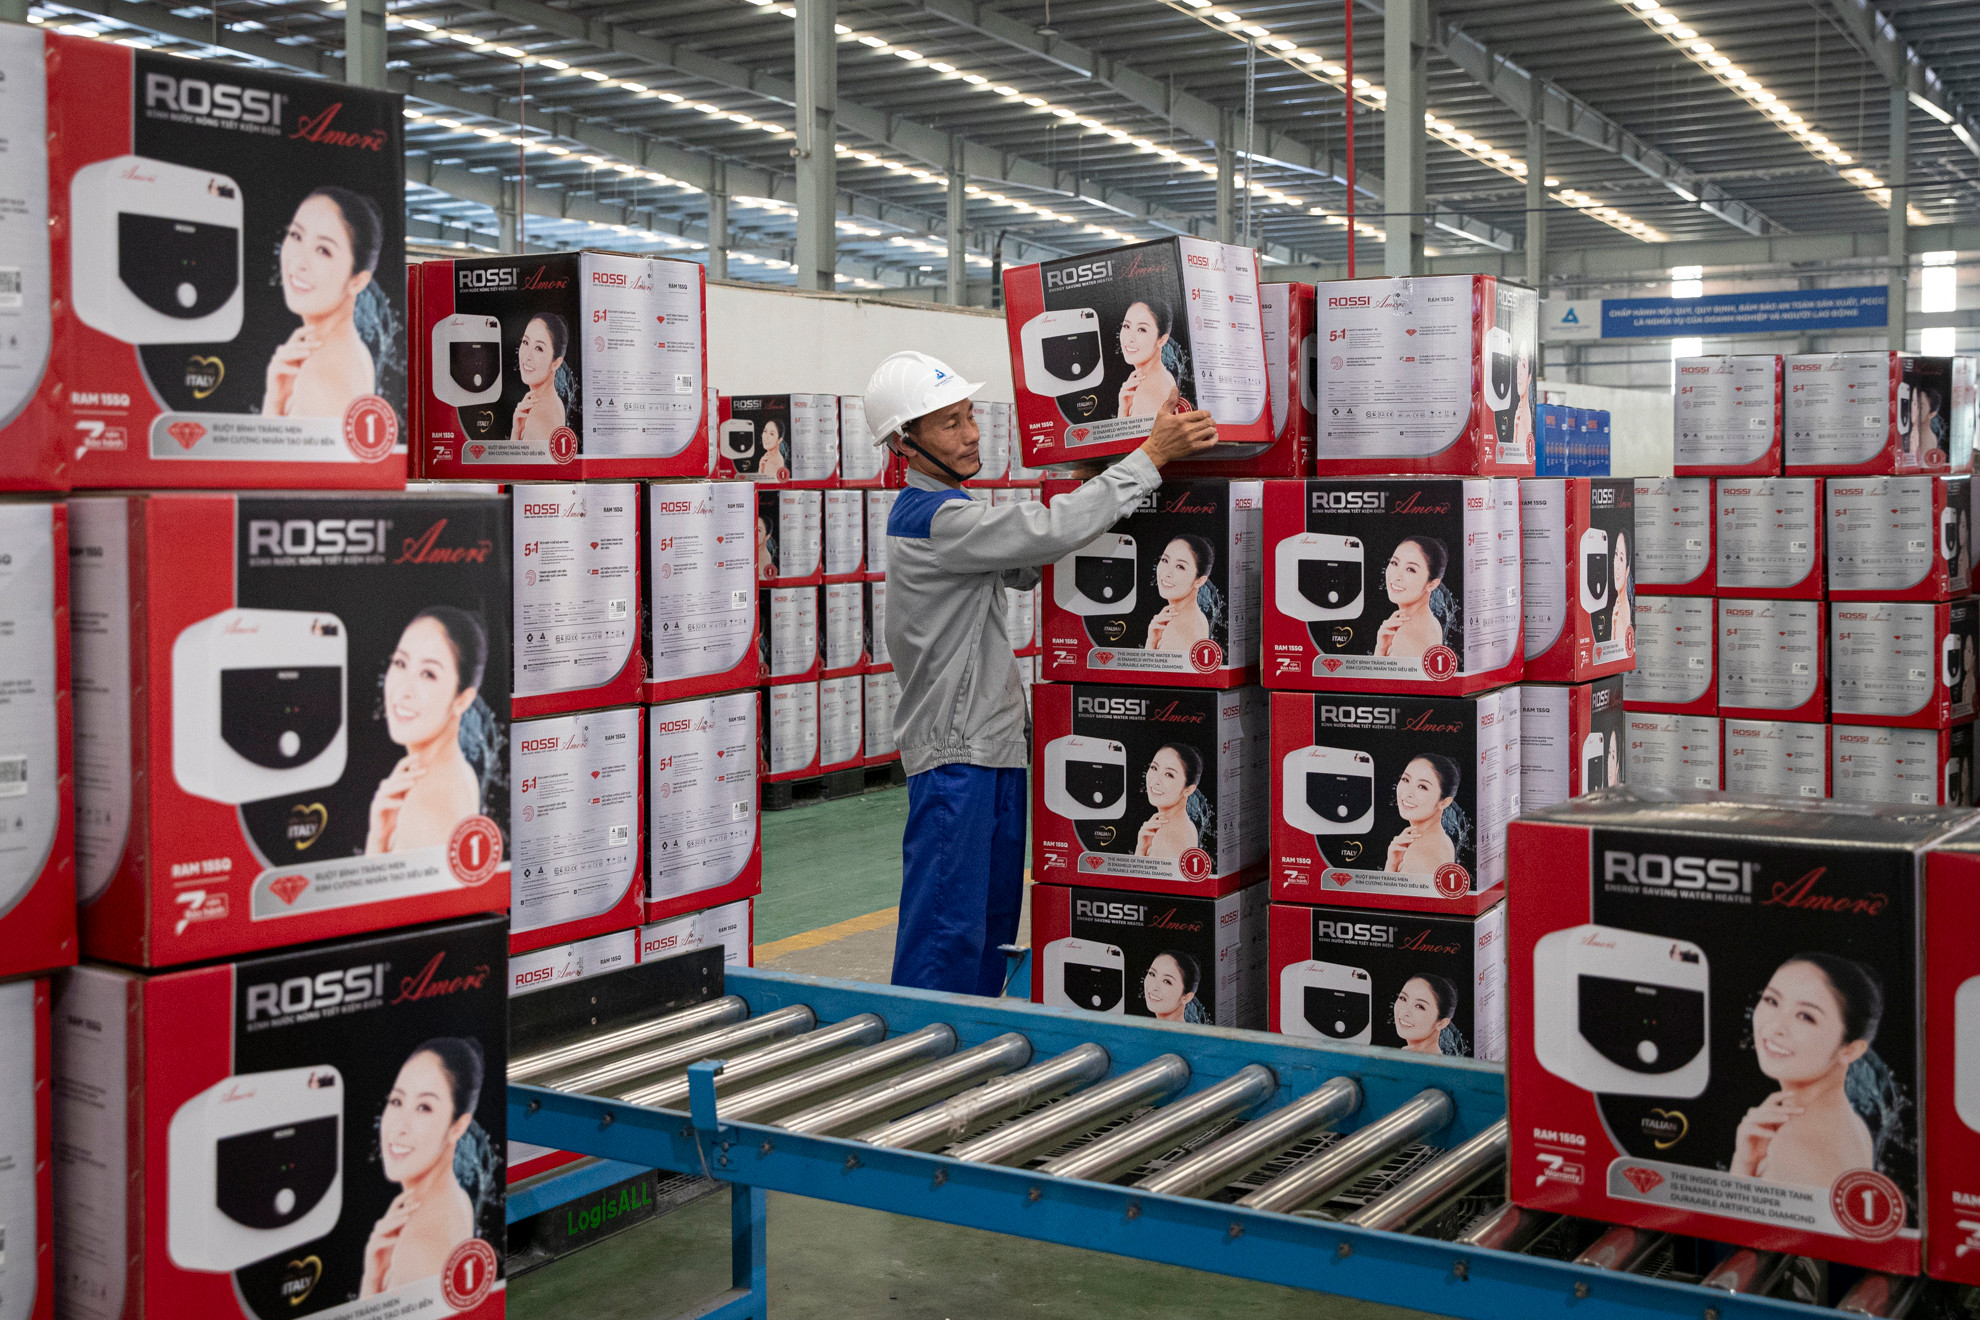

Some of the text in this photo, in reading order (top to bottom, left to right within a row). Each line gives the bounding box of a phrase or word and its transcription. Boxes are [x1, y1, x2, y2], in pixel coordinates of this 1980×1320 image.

[146, 73, 282, 126] ROSSI
[1188, 254, 1209, 266] ROSSI
[459, 268, 517, 288] ROSSI
[593, 272, 627, 285] ROSSI
[1046, 260, 1113, 287] ROSSI
[1329, 296, 1370, 307] ROSSI
[1681, 366, 1709, 374] ROSSI
[186, 372, 216, 388] ITALY
[71, 391, 99, 405] RAM
[733, 400, 762, 408] ROSSI
[1312, 491, 1385, 508] ROSSI
[1592, 488, 1614, 503] ROSSI
[1723, 488, 1751, 496] ROSSI
[1834, 488, 1863, 496] ROSSI
[524, 503, 559, 515] ROSSI
[660, 501, 691, 512] ROSSI
[1235, 498, 1253, 509] ROSSI
[1467, 497, 1483, 508] ROSSI
[249, 519, 386, 555] ROSSI
[1726, 608, 1753, 617] ROSSI
[1839, 612, 1868, 620] ROSSI
[1078, 697, 1146, 715] ROSSI
[1592, 690, 1610, 708] ROSSI
[1223, 705, 1240, 717] ROSSI
[1321, 705, 1396, 724] ROSSI
[660, 719, 690, 733] ROSSI
[1631, 722, 1658, 730] ROSSI
[1733, 728, 1760, 737] ROSSI
[521, 737, 558, 752] ROSSI
[1840, 735, 1869, 743] ROSSI
[287, 823, 318, 838] ITALY
[1341, 849, 1357, 857] ITALY
[171, 861, 198, 878] RAM
[1604, 850, 1752, 894] ROSSI
[1605, 884, 1752, 904] ENERGY SAVING WATER HEATER
[1076, 900, 1144, 921] ROSSI
[1220, 910, 1239, 925] ROSSI
[1319, 920, 1393, 943] ROSSI
[644, 935, 677, 952] ROSSI
[515, 967, 553, 985] ROSSI
[600, 957, 611, 965] RAM
[246, 963, 384, 1021] ROSSI
[1641, 1117, 1677, 1132] ITALIAN
[1533, 1128, 1557, 1140] RAM
[1536, 1152, 1563, 1187] 7
[1544, 1167, 1580, 1183] Warranty
[1670, 1171, 1814, 1202] THE INSIDE OF THE WATER TANK
[1670, 1182, 1679, 1191] IS
[1724, 1190, 1749, 1202] WITH
[1751, 1195, 1780, 1207] SUPER
[567, 1182, 652, 1236] LogisALL
[1719, 1201, 1767, 1216] ARTIFICIAL
[1768, 1209, 1816, 1225] DIAMOND
[281, 1275, 313, 1295] ITALY
